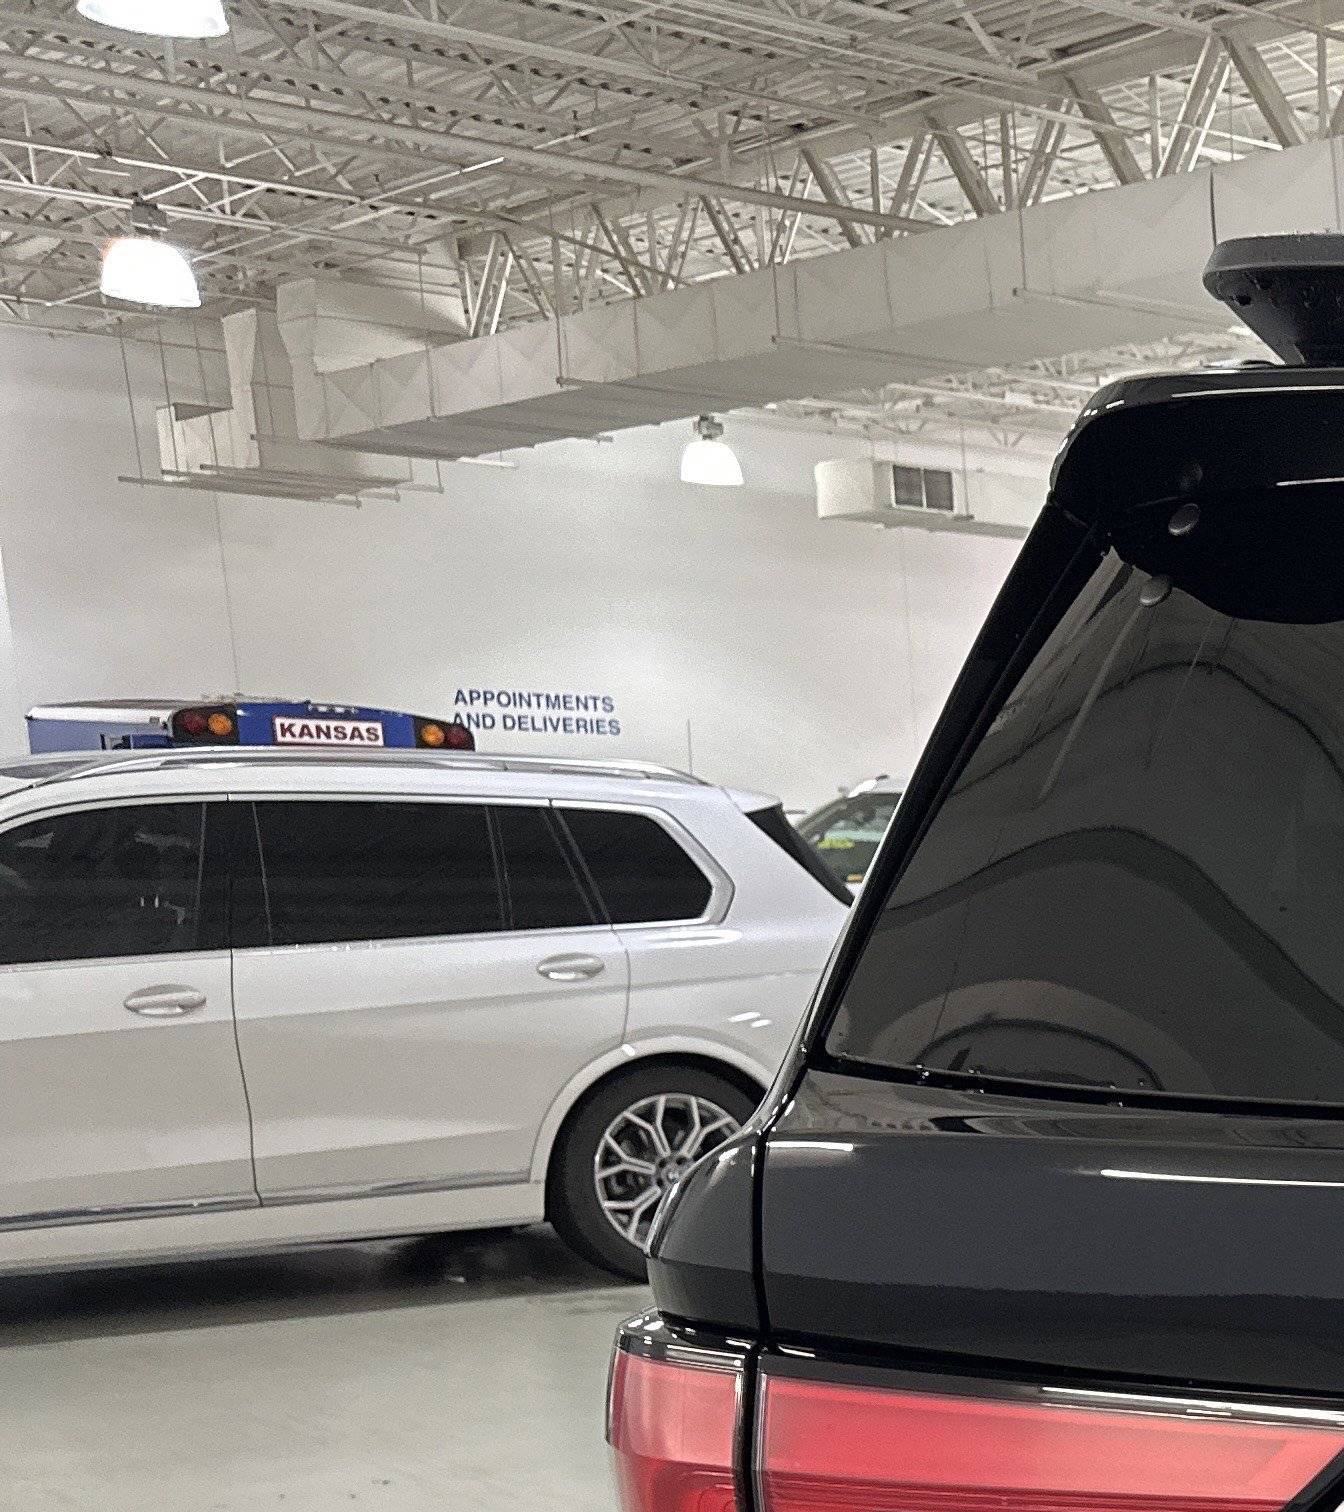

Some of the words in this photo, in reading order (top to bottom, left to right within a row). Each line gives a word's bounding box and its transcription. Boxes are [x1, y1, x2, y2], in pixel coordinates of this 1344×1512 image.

[454, 688, 615, 713] APPOINTMENTS
[279, 721, 380, 744] KANSAS
[452, 712, 495, 730] AND
[502, 714, 621, 736] DELIVERIES
